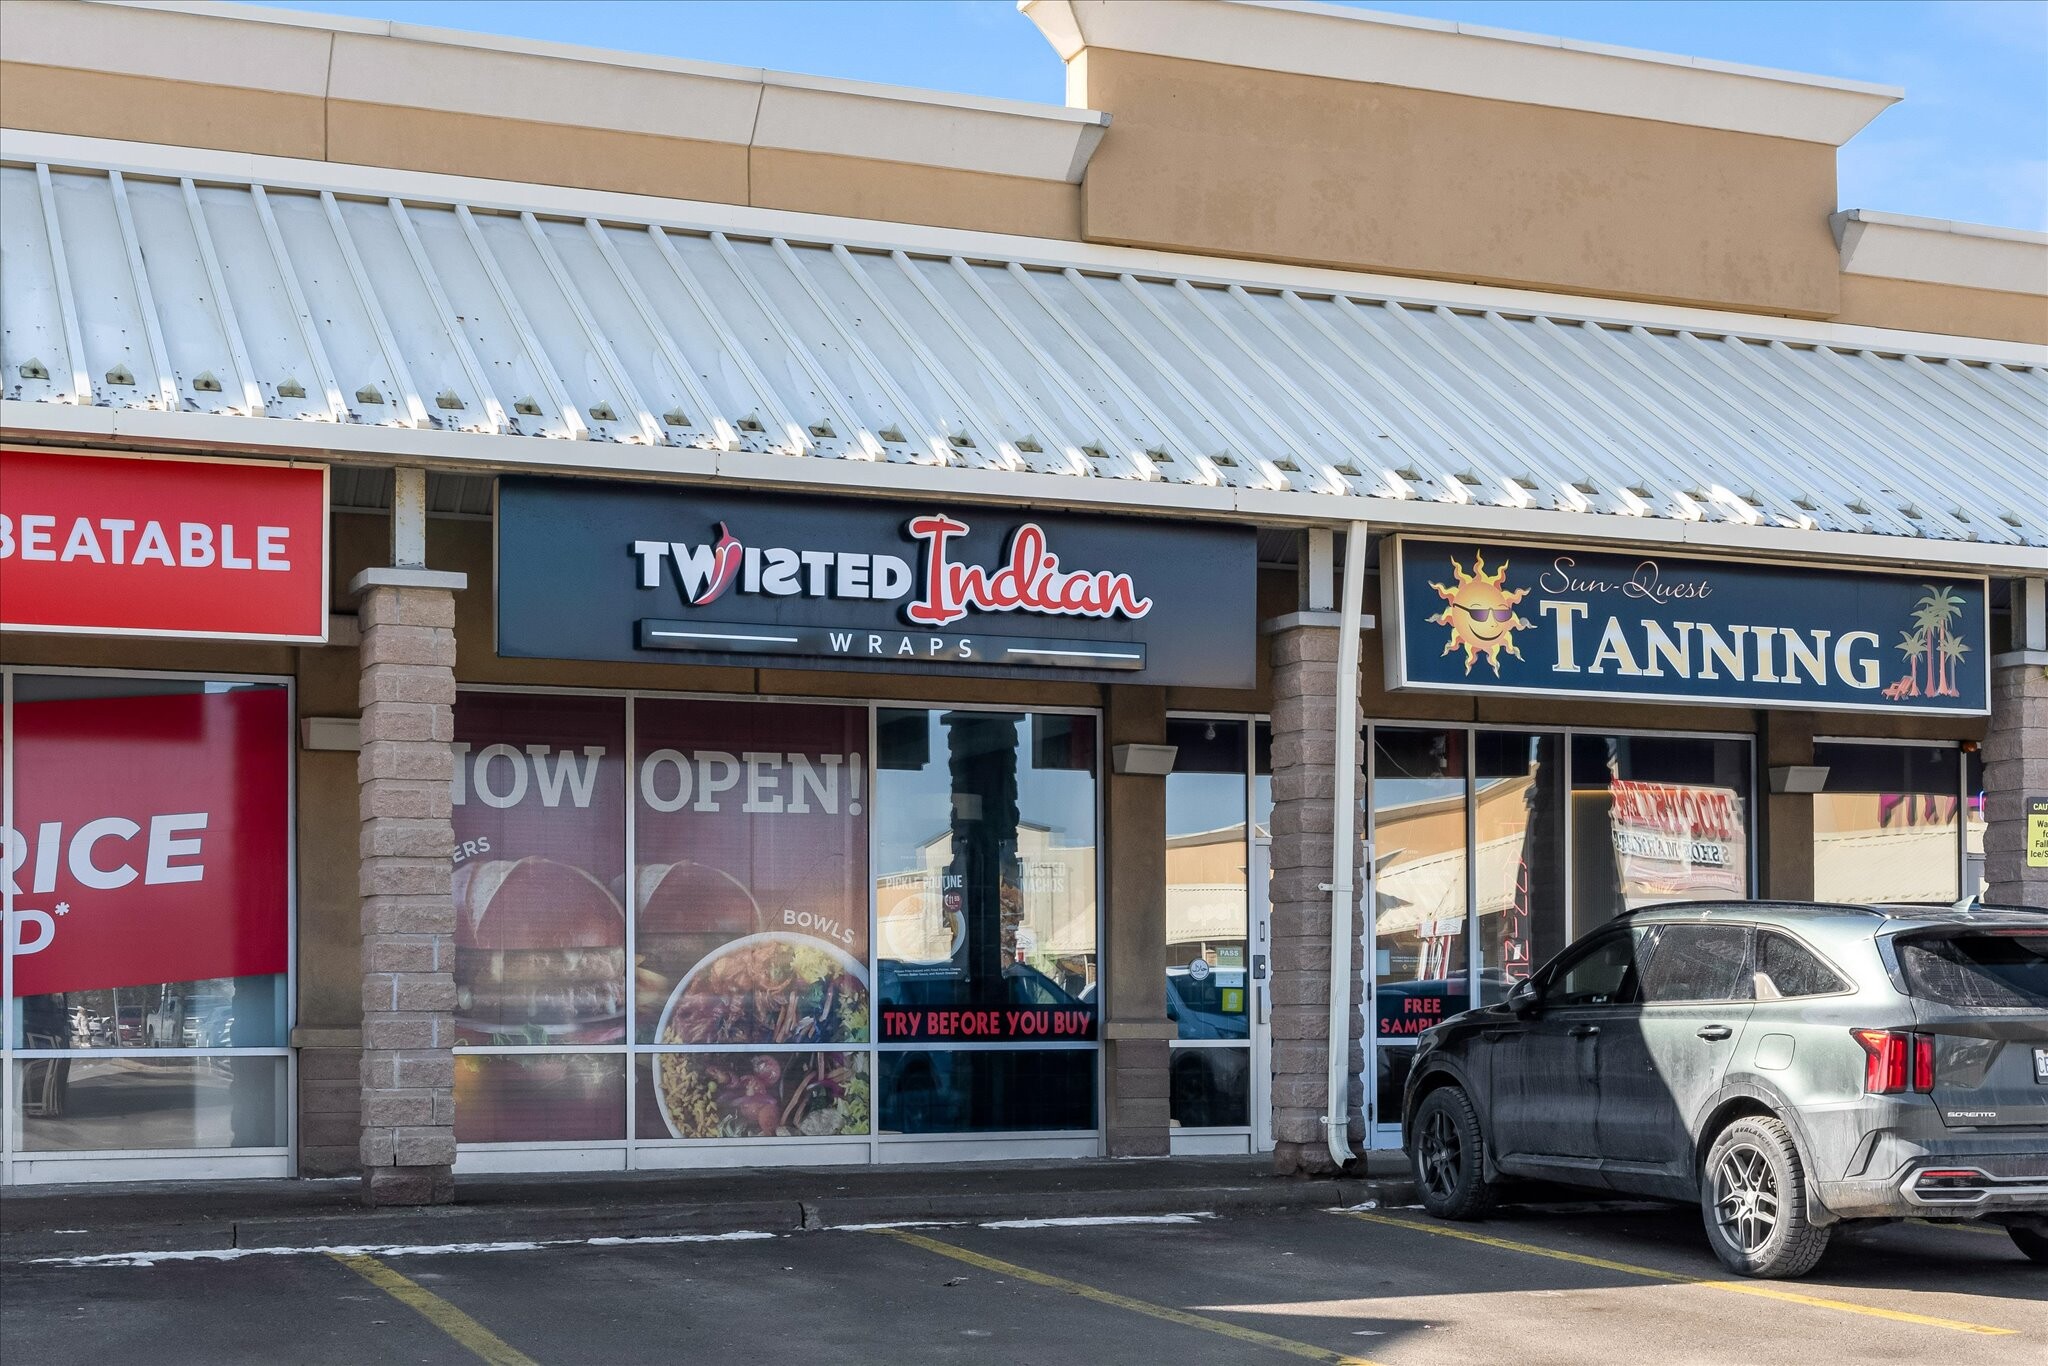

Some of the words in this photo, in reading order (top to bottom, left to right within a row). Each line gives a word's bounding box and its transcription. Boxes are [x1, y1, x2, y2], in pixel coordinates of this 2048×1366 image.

[634, 538, 913, 604] TWISTED
[906, 513, 1153, 627] Indian
[1539, 556, 1713, 605] Sun-Quest
[829, 632, 974, 659] WRAPS
[1539, 599, 1881, 689] TANNING
[639, 748, 863, 816] OPEN!
[783, 909, 855, 944] BOWLS
[1219, 949, 1239, 957] PASS
[884, 1011, 922, 1036] TRY
[927, 1011, 1001, 1036] BEFORE
[1006, 1011, 1048, 1036] YOU
[1053, 1010, 1091, 1035] BUY
[1404, 998, 1441, 1014] FREE
